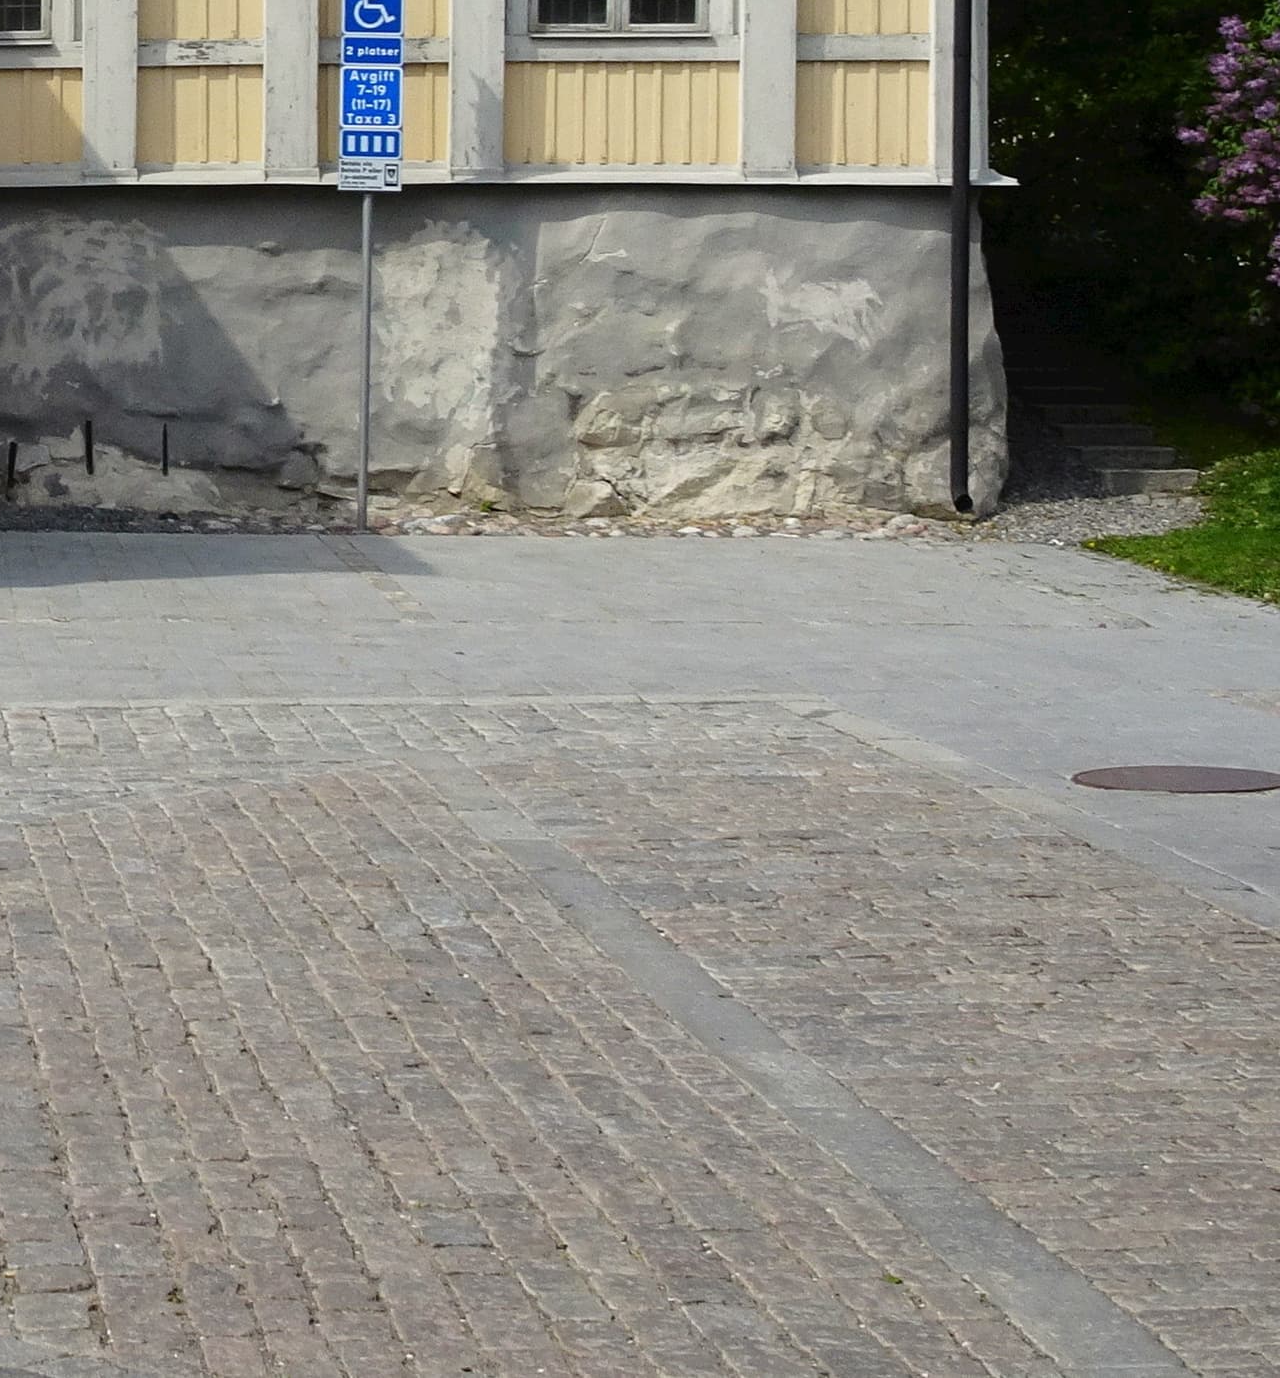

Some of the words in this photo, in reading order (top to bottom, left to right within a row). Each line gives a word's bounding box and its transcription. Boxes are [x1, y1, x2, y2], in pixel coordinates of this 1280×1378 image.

[345, 46, 354, 56] 2
[357, 46, 400, 57] platser
[349, 70, 395, 84] Avgift
[356, 84, 387, 96] 7-19
[351, 98, 391, 111] (11-17)
[346, 112, 382, 124] Taxa
[387, 113, 396, 124] 3
